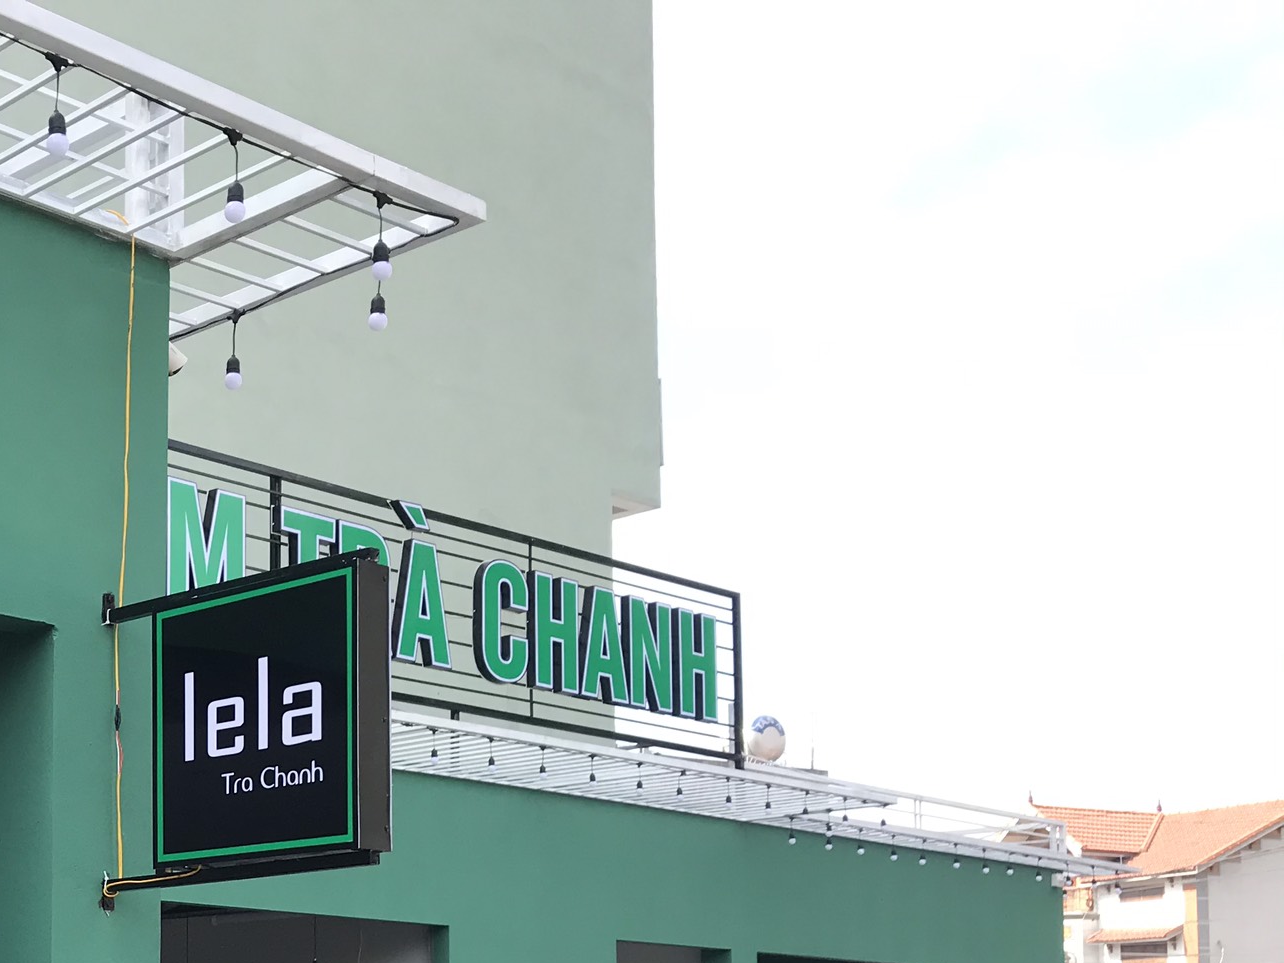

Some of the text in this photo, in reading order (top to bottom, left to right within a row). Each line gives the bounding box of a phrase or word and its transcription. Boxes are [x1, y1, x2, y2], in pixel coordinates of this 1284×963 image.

[474, 559, 719, 723] CHANH
[184, 656, 323, 762] lela
[220, 760, 324, 795] Tra Chanh
